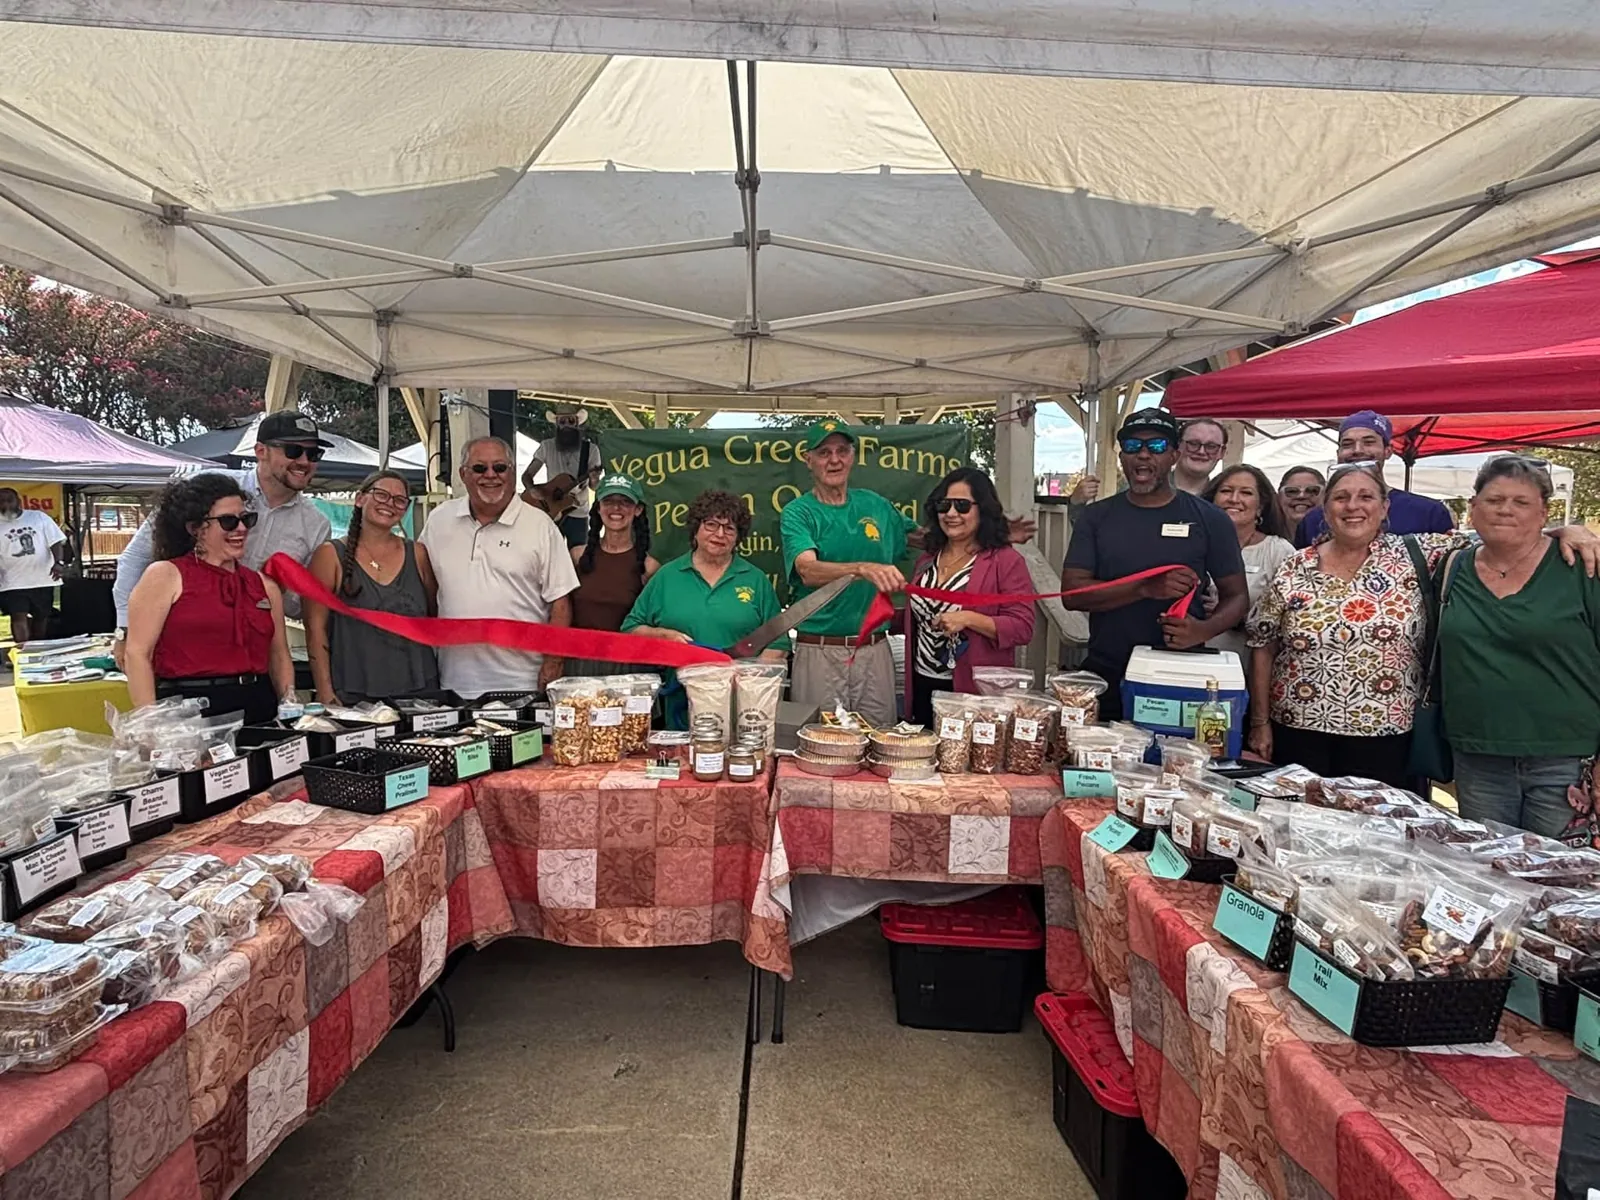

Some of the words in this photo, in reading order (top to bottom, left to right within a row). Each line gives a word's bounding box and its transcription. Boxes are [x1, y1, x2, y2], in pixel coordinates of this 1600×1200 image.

[724, 435, 809, 466] Cree
[858, 436, 961, 477] Farms
[209, 768, 229, 778] Vegan
[397, 773, 415, 781] Texas
[1078, 773, 1097, 781] Fresh
[141, 786, 165, 796] Charro
[1226, 892, 1265, 921] Granola
[1313, 956, 1333, 979] Trail
[1313, 972, 1328, 990] Mix
